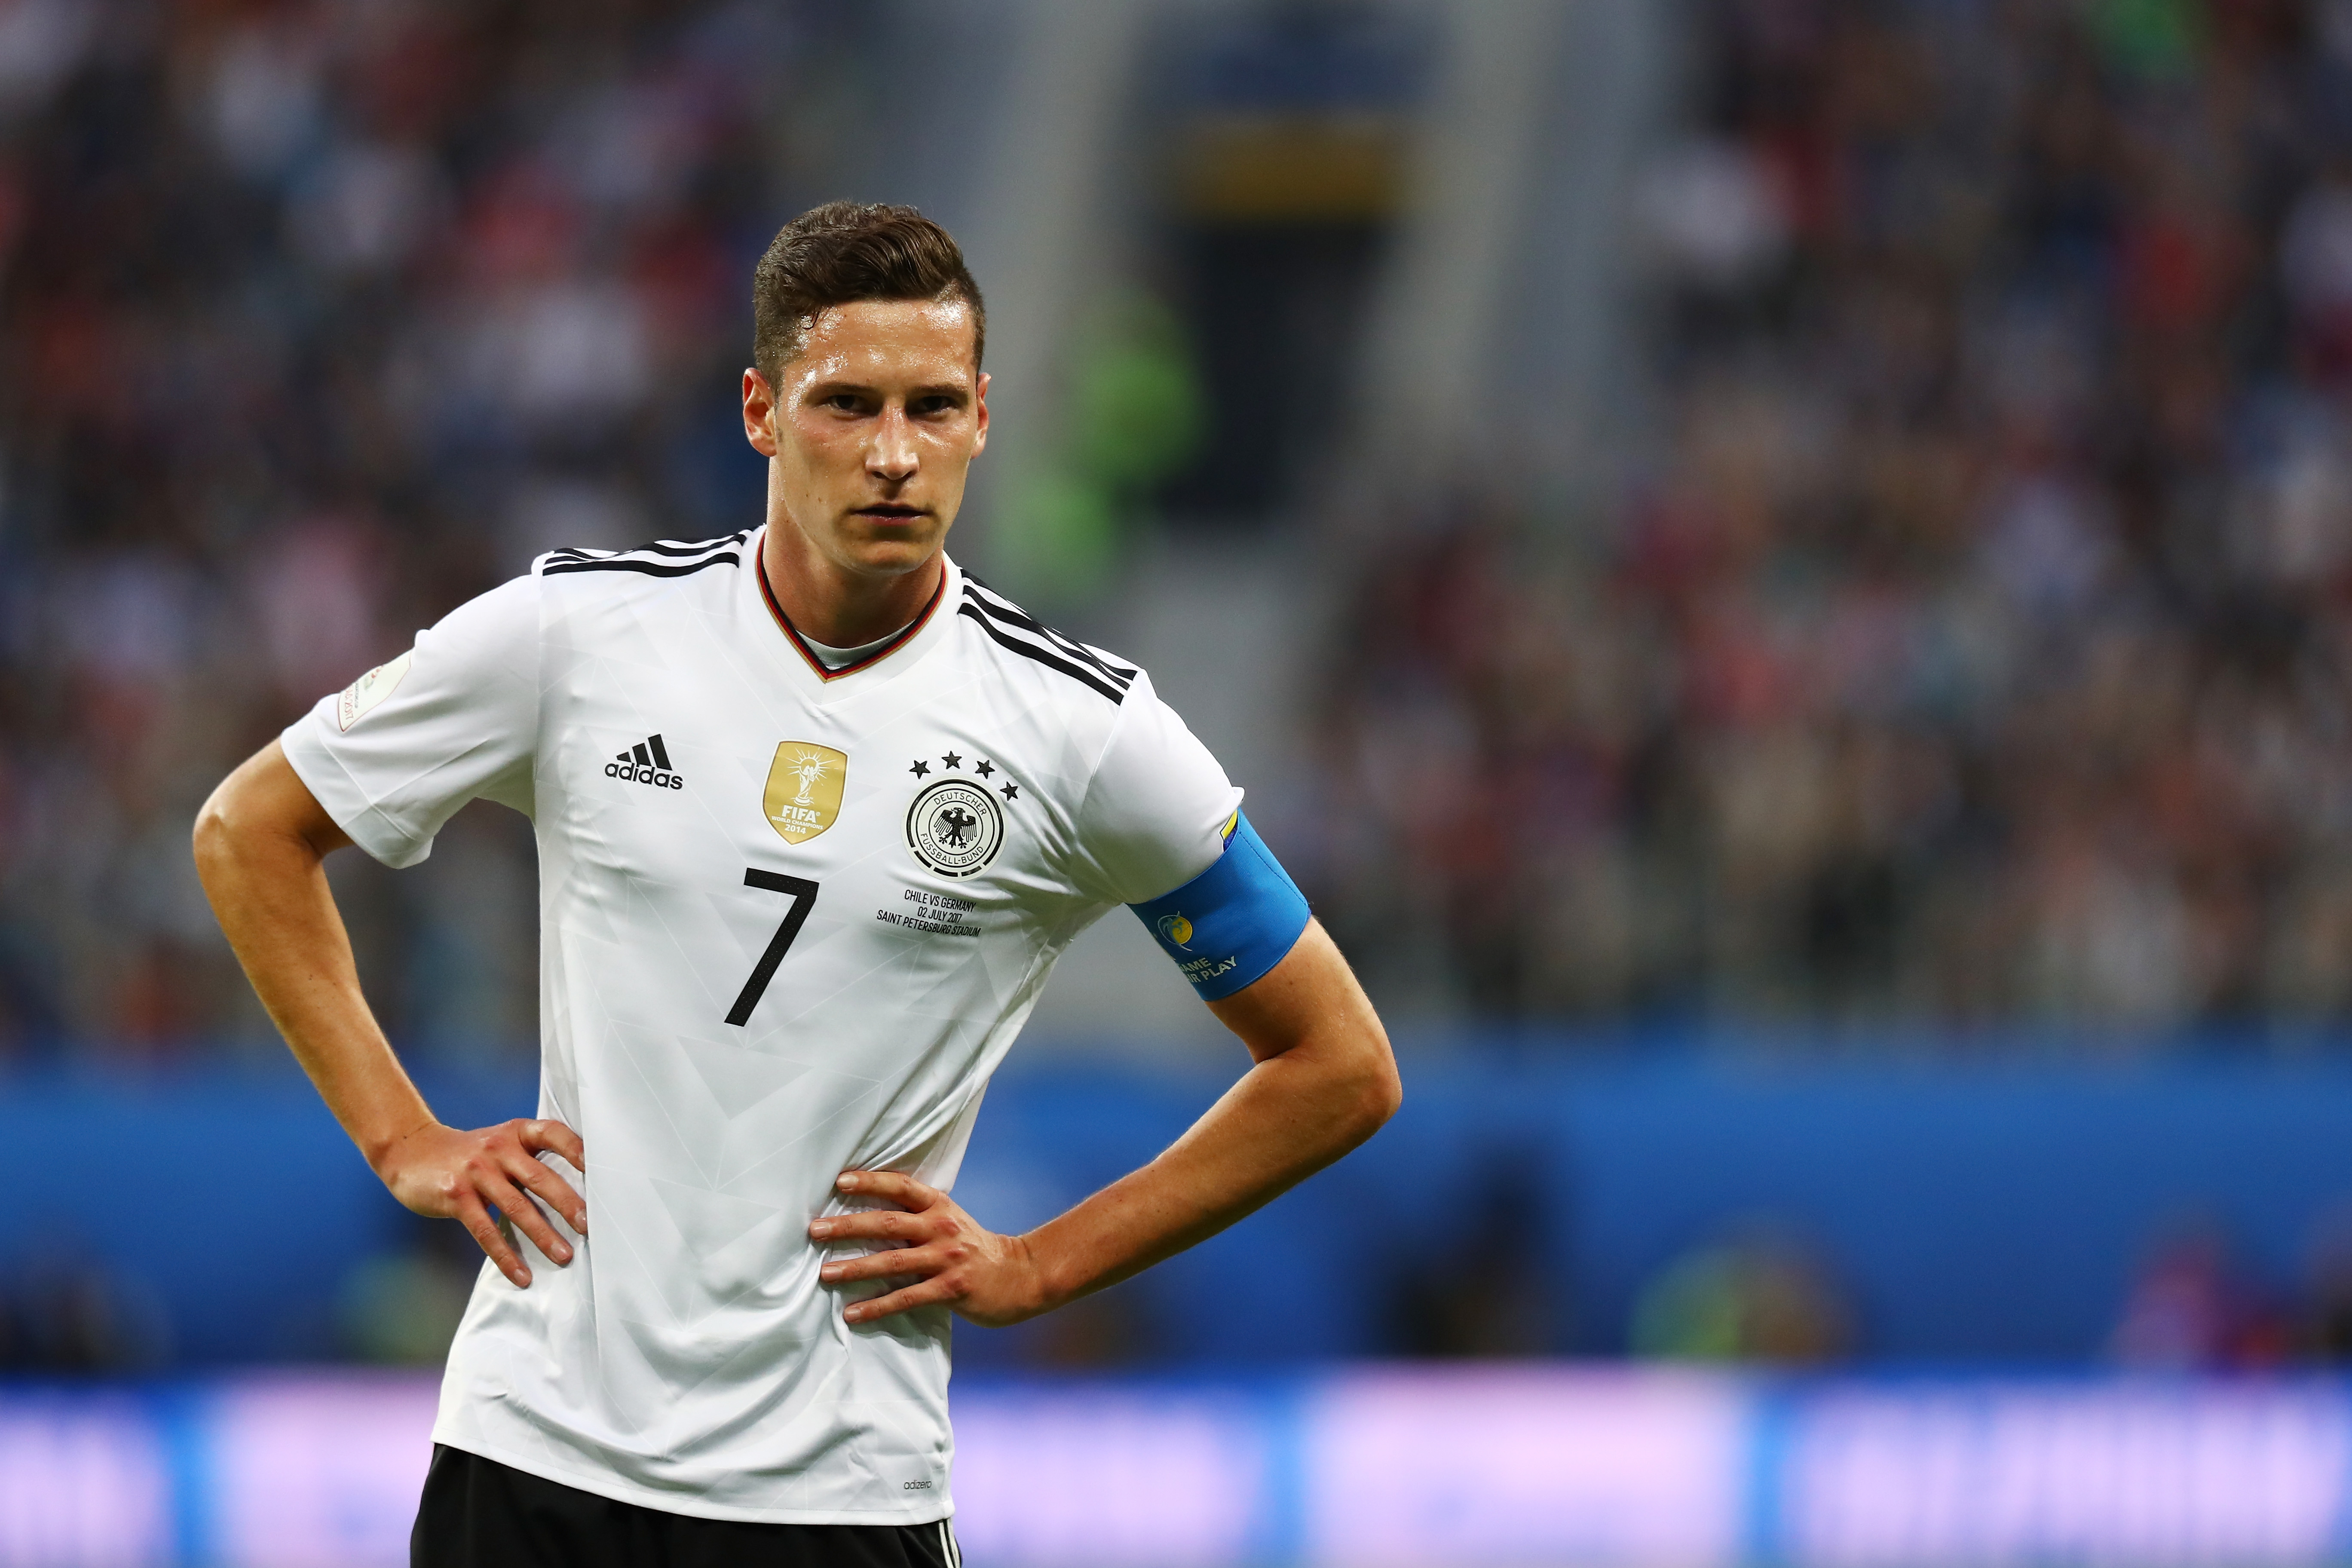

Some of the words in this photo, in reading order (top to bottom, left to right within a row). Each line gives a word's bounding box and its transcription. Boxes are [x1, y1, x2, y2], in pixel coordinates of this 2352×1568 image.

[605, 762, 683, 790] adidas
[782, 805, 817, 823] FIFA
[934, 792, 987, 816] DEUTSCHER
[785, 824, 806, 834] 2014
[792, 820, 824, 830] CHAMPIONS
[921, 833, 983, 864] FUSSBALL-BUND
[904, 889, 928, 904] CHILE
[930, 894, 940, 906] VS
[941, 897, 977, 913] GERMANY
[877, 910, 903, 925] SAINT
[903, 916, 952, 934] PETERSBURG
[951, 925, 982, 937] STADIUM
[917, 906, 928, 918] 02
[928, 909, 948, 922] JULY
[947, 913, 963, 923] 2017
[724, 867, 820, 1027] 7
[1200, 956, 1237, 980] PLAY
[904, 1479, 932, 1490] adizero
